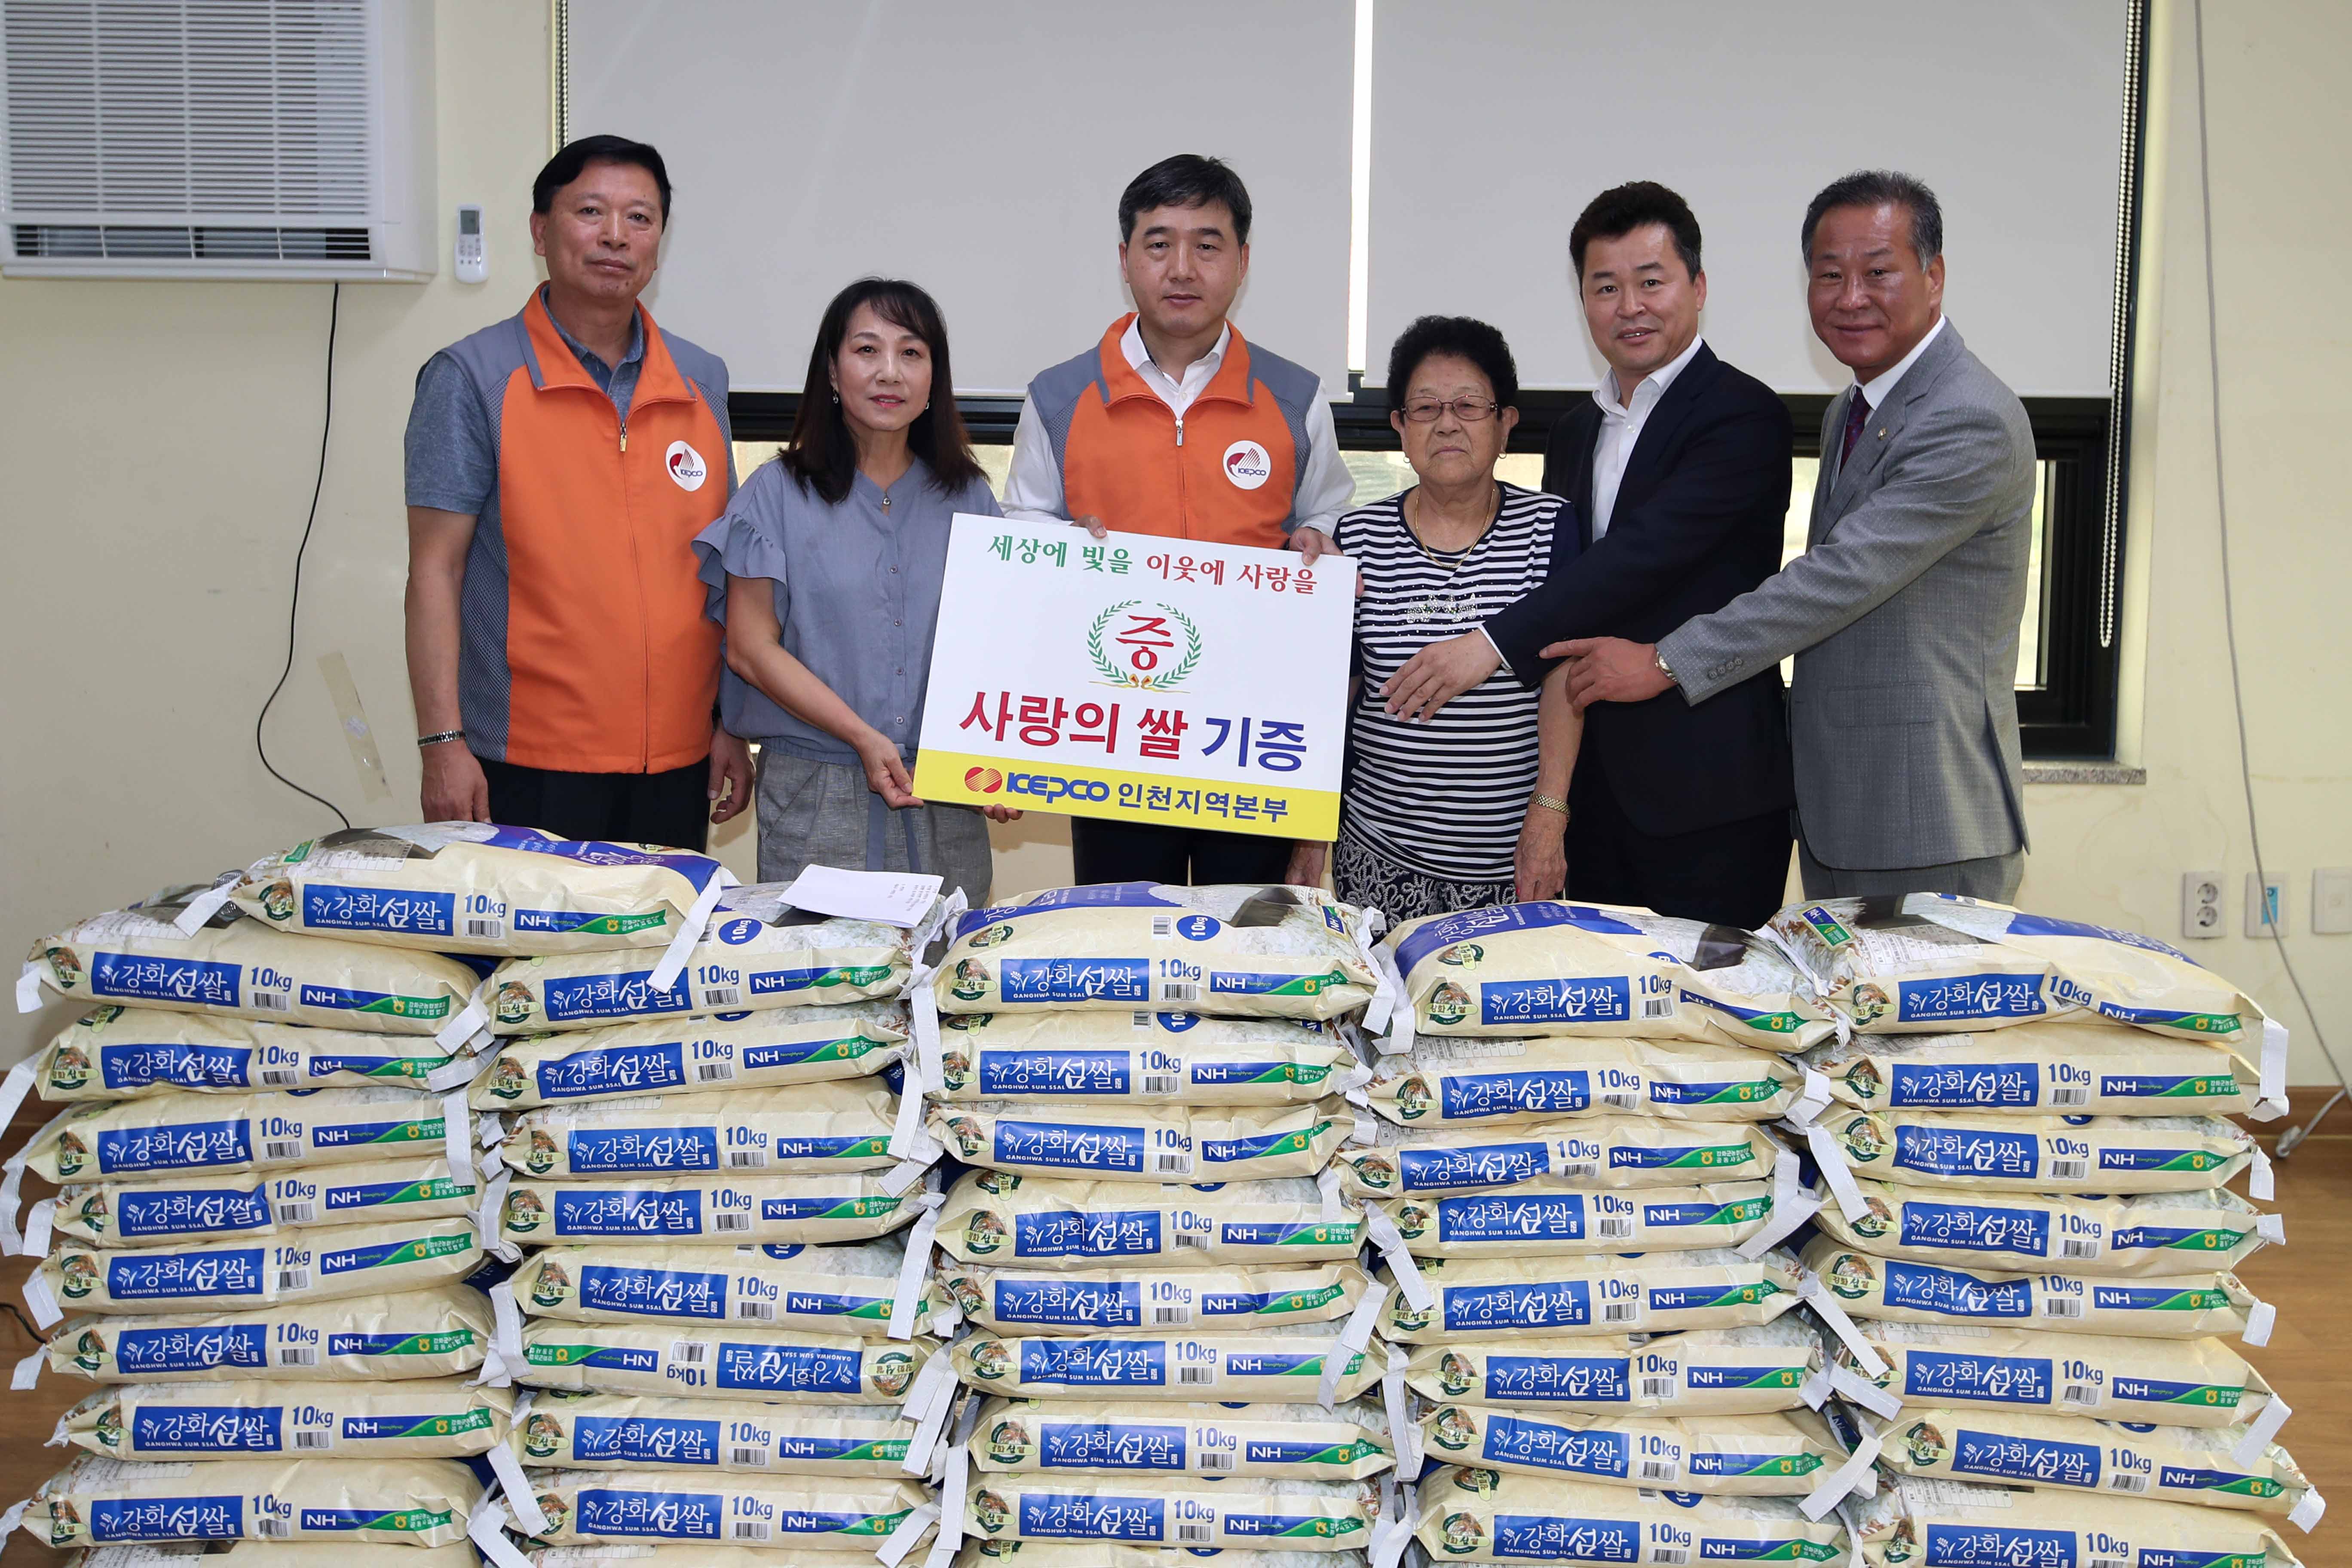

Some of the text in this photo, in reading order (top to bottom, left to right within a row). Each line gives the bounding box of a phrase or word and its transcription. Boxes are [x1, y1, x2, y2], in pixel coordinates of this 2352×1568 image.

[680, 469, 703, 478] KEPCO
[1238, 468, 1267, 476] KEPCO
[987, 534, 1318, 595] 세상에 빛을 이웃에 사랑을
[1115, 614, 1174, 671] 증
[959, 691, 1308, 772] 사랑의 쌀 기증
[1007, 772, 1289, 824] KEPCO 인천지역본부
[334, 894, 441, 930] 강화섬쌀
[465, 894, 507, 919] 10kg
[520, 914, 551, 927] NH
[731, 919, 752, 940] 10kg
[1191, 916, 1209, 937] 10kg
[123, 963, 227, 1000] 강화섬쌀
[251, 966, 293, 992] 10kg
[698, 964, 741, 986] 10kg
[1030, 964, 1132, 996] 강화섬쌀
[1159, 958, 1202, 982] 10kg
[755, 976, 785, 989] NH
[1216, 977, 1246, 989] NH
[1638, 974, 1672, 994] 10kg
[2049, 976, 2093, 1006] 10kg
[306, 990, 336, 1004] NH
[1512, 985, 1618, 1017] 강화섬쌀
[1930, 981, 2034, 1012] 강화섬쌀
[258, 1045, 300, 1066] 10kg
[691, 1039, 734, 1060] 10kg
[749, 1050, 779, 1064] NH
[134, 1049, 237, 1082] 강화섬쌀
[567, 1052, 671, 1086] 강화섬쌀
[1009, 1057, 1113, 1089] 강화섬쌀
[1140, 1050, 1182, 1073] 10kg
[1197, 1067, 1227, 1080] NH
[1598, 1069, 1641, 1090] 10kg
[2049, 1063, 2091, 1085] 10kg
[1471, 1078, 1578, 1109] 강화섬쌀
[1654, 1086, 1681, 1099] NH
[1922, 1070, 2027, 1102] 강화섬쌀
[2107, 1081, 2137, 1092] NH
[260, 1117, 303, 1138] 10kg
[318, 1130, 349, 1142] NH
[726, 1125, 769, 1149] 10kg
[130, 1131, 236, 1162] 강화섬쌀
[598, 1134, 705, 1167] 강화섬쌀
[783, 1142, 813, 1154] NH
[1024, 1129, 1132, 1165] 강화섬쌀
[1155, 1129, 1193, 1152] 10kg
[1207, 1144, 1237, 1159] NH
[1557, 1139, 1600, 1159] 10kg
[2045, 1136, 2089, 1158] 10kg
[1613, 1151, 1642, 1164] NH
[1923, 1135, 2027, 1172] 강화섬쌀
[2104, 1153, 2135, 1165] NH
[1431, 1152, 1537, 1182] 강화섬쌀
[275, 1179, 317, 1200] 10kg
[331, 1191, 361, 1204] NH
[711, 1189, 753, 1210] 10kg
[150, 1195, 256, 1227] 강화섬쌀
[585, 1197, 689, 1230] 강화섬쌀
[767, 1203, 797, 1215] NH
[1592, 1194, 1635, 1216] 10kg
[1650, 1209, 1680, 1222] NH
[1170, 1210, 1213, 1233] 10kg
[1467, 1201, 1573, 1234] 강화섬쌀
[2060, 1213, 2102, 1238] 10kg
[1046, 1213, 1149, 1251] 강화섬쌀
[1227, 1228, 1258, 1240] NH
[1932, 1211, 2037, 1249] 강화섬쌀
[2117, 1231, 2144, 1246] NH
[274, 1246, 311, 1266] 10kg
[326, 1254, 356, 1269] NH
[141, 1258, 251, 1291] 강화섬쌀
[2040, 1275, 2084, 1295] 10kg
[609, 1275, 715, 1313] 강화섬쌀
[737, 1276, 778, 1301] 10kg
[1150, 1281, 1192, 1305] 10kg
[1599, 1279, 1639, 1299] 10kg
[1655, 1292, 1685, 1305] NH
[1915, 1274, 2025, 1312] 강화섬쌀
[2099, 1291, 2131, 1305] NH
[792, 1297, 822, 1310] NH
[1024, 1284, 1132, 1322] 강화섬쌀
[1207, 1297, 1237, 1311] NH
[1473, 1285, 1579, 1323] 강화섬쌀
[277, 1323, 319, 1345] 10kg
[334, 1338, 362, 1351] NH
[148, 1333, 254, 1363] 강화섬쌀
[1176, 1341, 1217, 1365] 10kg
[622, 1354, 652, 1367] NH
[729, 1350, 831, 1386] 강화섬쌀
[1051, 1346, 1154, 1380] 강화섬쌀
[1231, 1359, 1262, 1371] NH
[1638, 1354, 1678, 1376] 10kg
[666, 1363, 707, 1387] 10kg
[1515, 1363, 1620, 1396] 강화섬쌀
[1692, 1371, 1723, 1384] NH
[1936, 1361, 2042, 1398] 강화섬쌀
[2063, 1361, 2104, 1385] 10kg
[2118, 1382, 2149, 1396] NH
[291, 1406, 334, 1428] 10kg
[348, 1422, 378, 1434] NH
[164, 1412, 269, 1447] 강화섬쌀
[603, 1423, 707, 1459] 강화섬쌀
[729, 1423, 771, 1446] 10kg
[1197, 1427, 1237, 1451] 10kg
[785, 1440, 815, 1455] NH
[1070, 1430, 1175, 1464] 강화섬쌀
[1251, 1446, 1281, 1458] NH
[1513, 1430, 1619, 1470] 강화섬쌀
[1640, 1435, 1681, 1461] 10kg
[1694, 1456, 1722, 1470] NH
[1985, 1443, 2090, 1482] 강화섬쌀
[2111, 1448, 2152, 1474] 10kg
[2165, 1471, 2196, 1485] NH
[252, 1494, 293, 1519] 10kg
[605, 1498, 710, 1534] 강화섬쌀
[732, 1496, 774, 1520] 10kg
[1174, 1499, 1216, 1523] 10kg
[123, 1504, 230, 1536] 강화섬쌀
[306, 1514, 337, 1526] NH
[787, 1516, 817, 1528] NH
[1048, 1501, 1153, 1536] 강화섬쌀
[1230, 1519, 1259, 1531] NH
[1523, 1523, 1628, 1558] 강화섬쌀
[1650, 1523, 1692, 1547] 10kg
[2086, 1533, 2129, 1557] 10kg
[1706, 1543, 1736, 1556] NH
[1957, 1533, 2065, 1567] 강화섬쌀
[2144, 1554, 2174, 1567] NH
